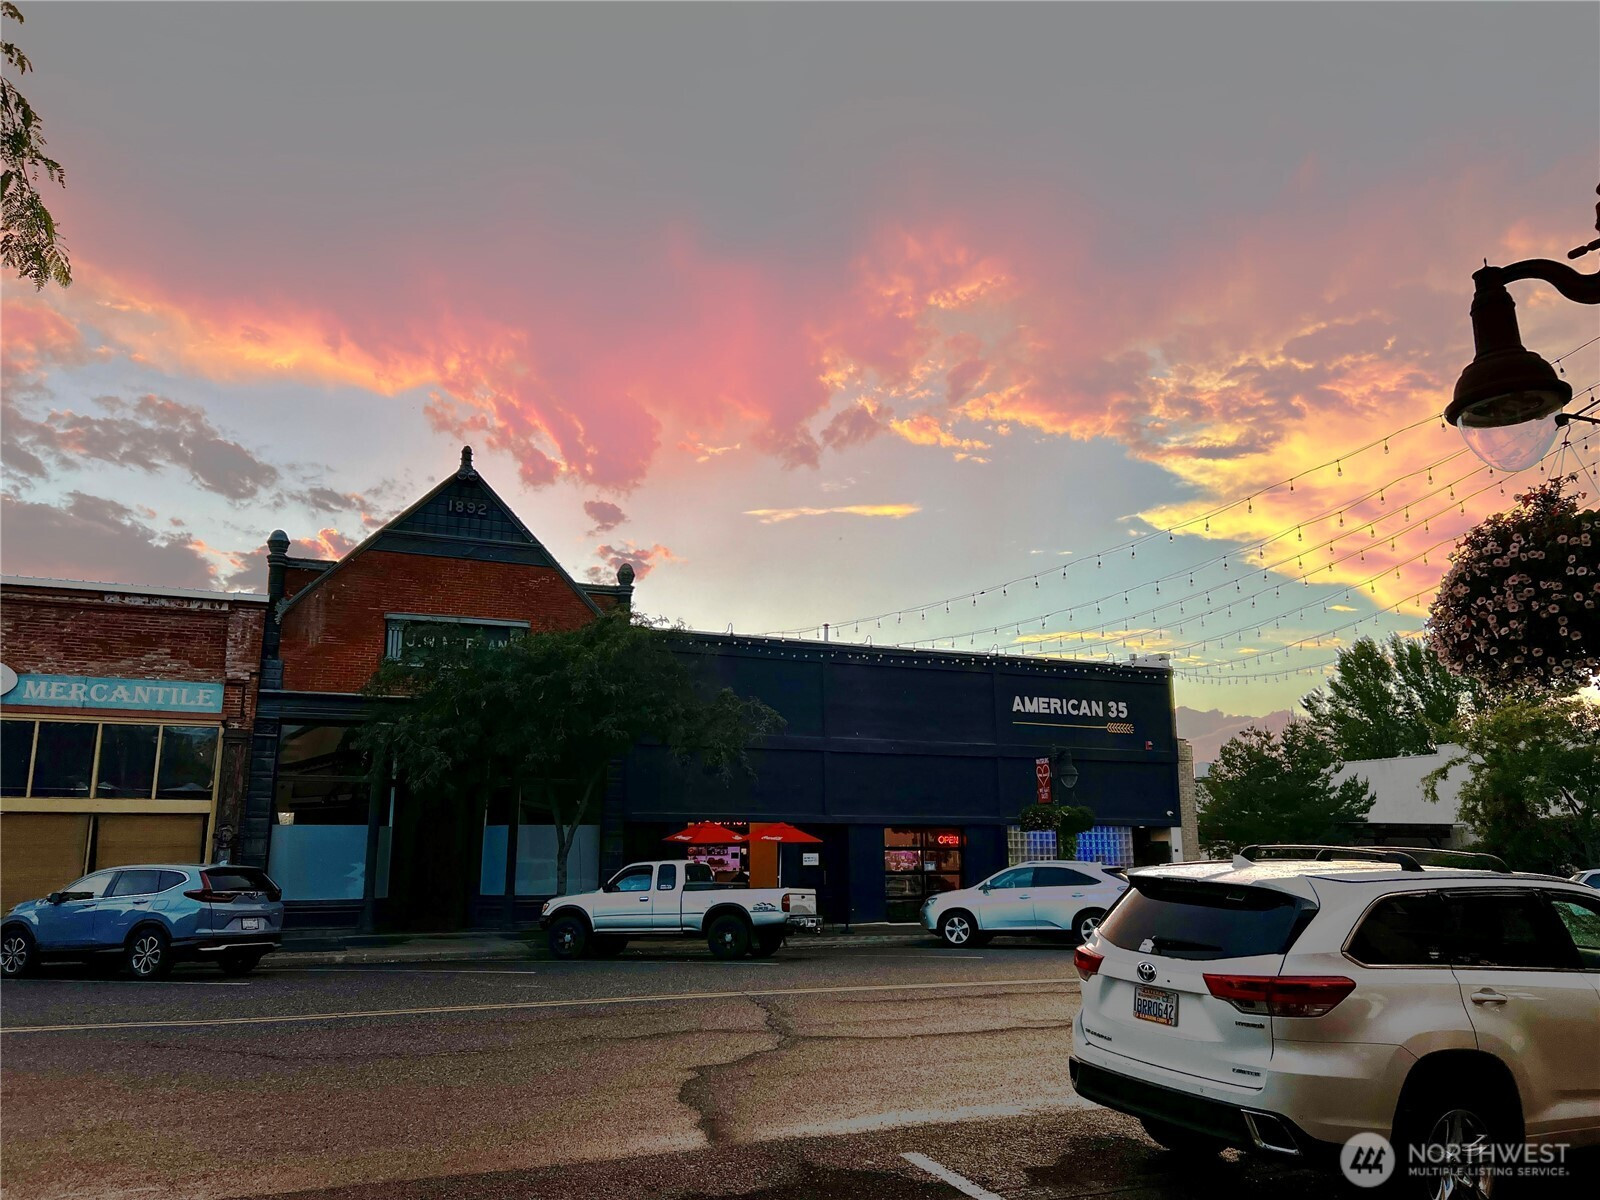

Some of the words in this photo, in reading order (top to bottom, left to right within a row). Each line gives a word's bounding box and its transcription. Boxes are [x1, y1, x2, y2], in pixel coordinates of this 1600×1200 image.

[448, 499, 487, 515] 1892
[22, 680, 216, 707] MERCANTILE
[1012, 695, 1104, 717] AMERICAN
[1107, 701, 1128, 719] 35
[937, 835, 959, 845] OPEN
[1137, 998, 1174, 1019] BRR0642
